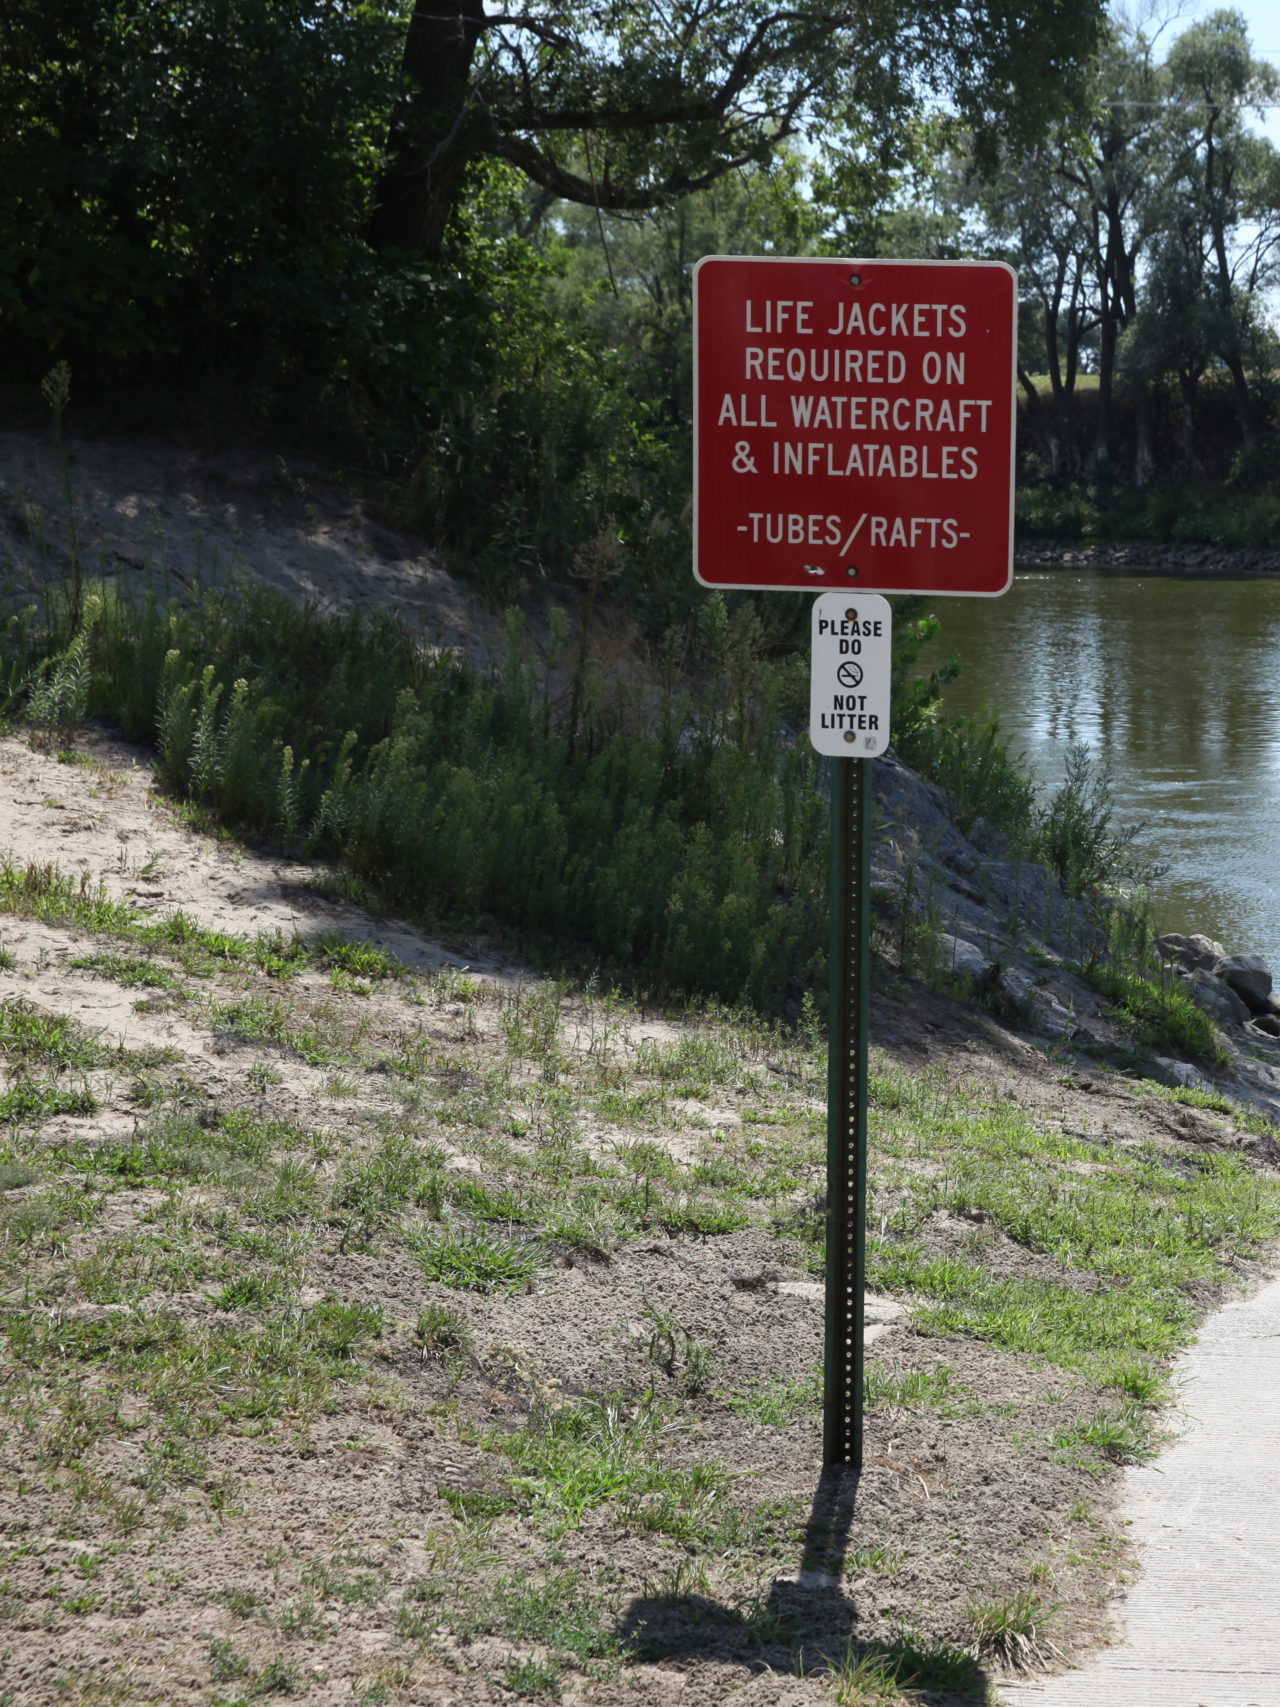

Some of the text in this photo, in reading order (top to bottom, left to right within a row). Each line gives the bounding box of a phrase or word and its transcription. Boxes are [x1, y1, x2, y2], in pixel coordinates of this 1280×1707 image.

[745, 299, 967, 338] LIFE JACKETS
[745, 347, 966, 385] REQUIRED ON
[717, 393, 993, 433] ALL WATERCRAFT
[731, 440, 979, 480] & INFLATABLES
[736, 512, 971, 557] -TUBES/RAFTS-
[818, 619, 883, 637] PLEASE
[839, 638, 862, 655] DO
[821, 713, 879, 730] LITTER
[833, 695, 868, 711] NOT
